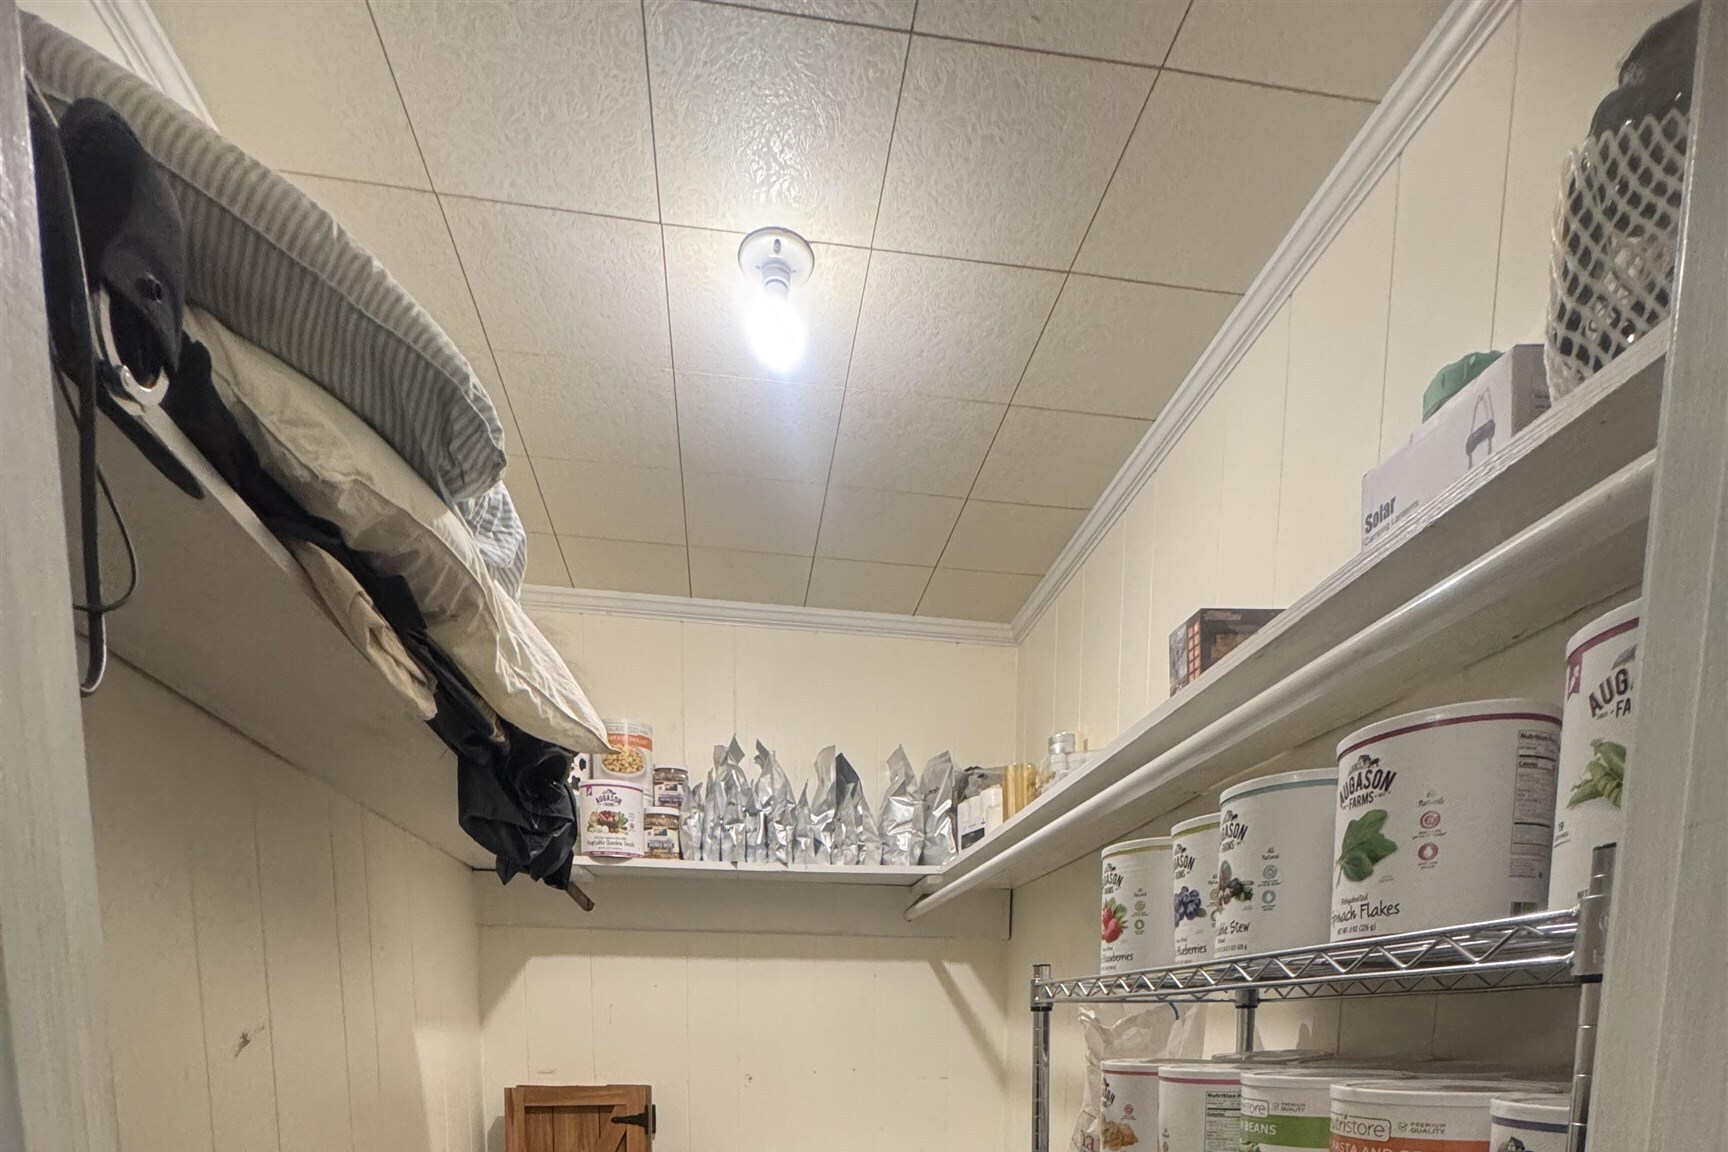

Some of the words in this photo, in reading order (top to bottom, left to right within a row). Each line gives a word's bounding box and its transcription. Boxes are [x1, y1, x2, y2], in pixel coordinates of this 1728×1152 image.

[1365, 496, 1396, 534] Solar
[1340, 769, 1397, 808] AUGASON
[1349, 791, 1374, 810] FARMS
[1360, 899, 1400, 919] Flakes
[1229, 920, 1251, 934] Stew
[1244, 1121, 1277, 1135] BEANS
